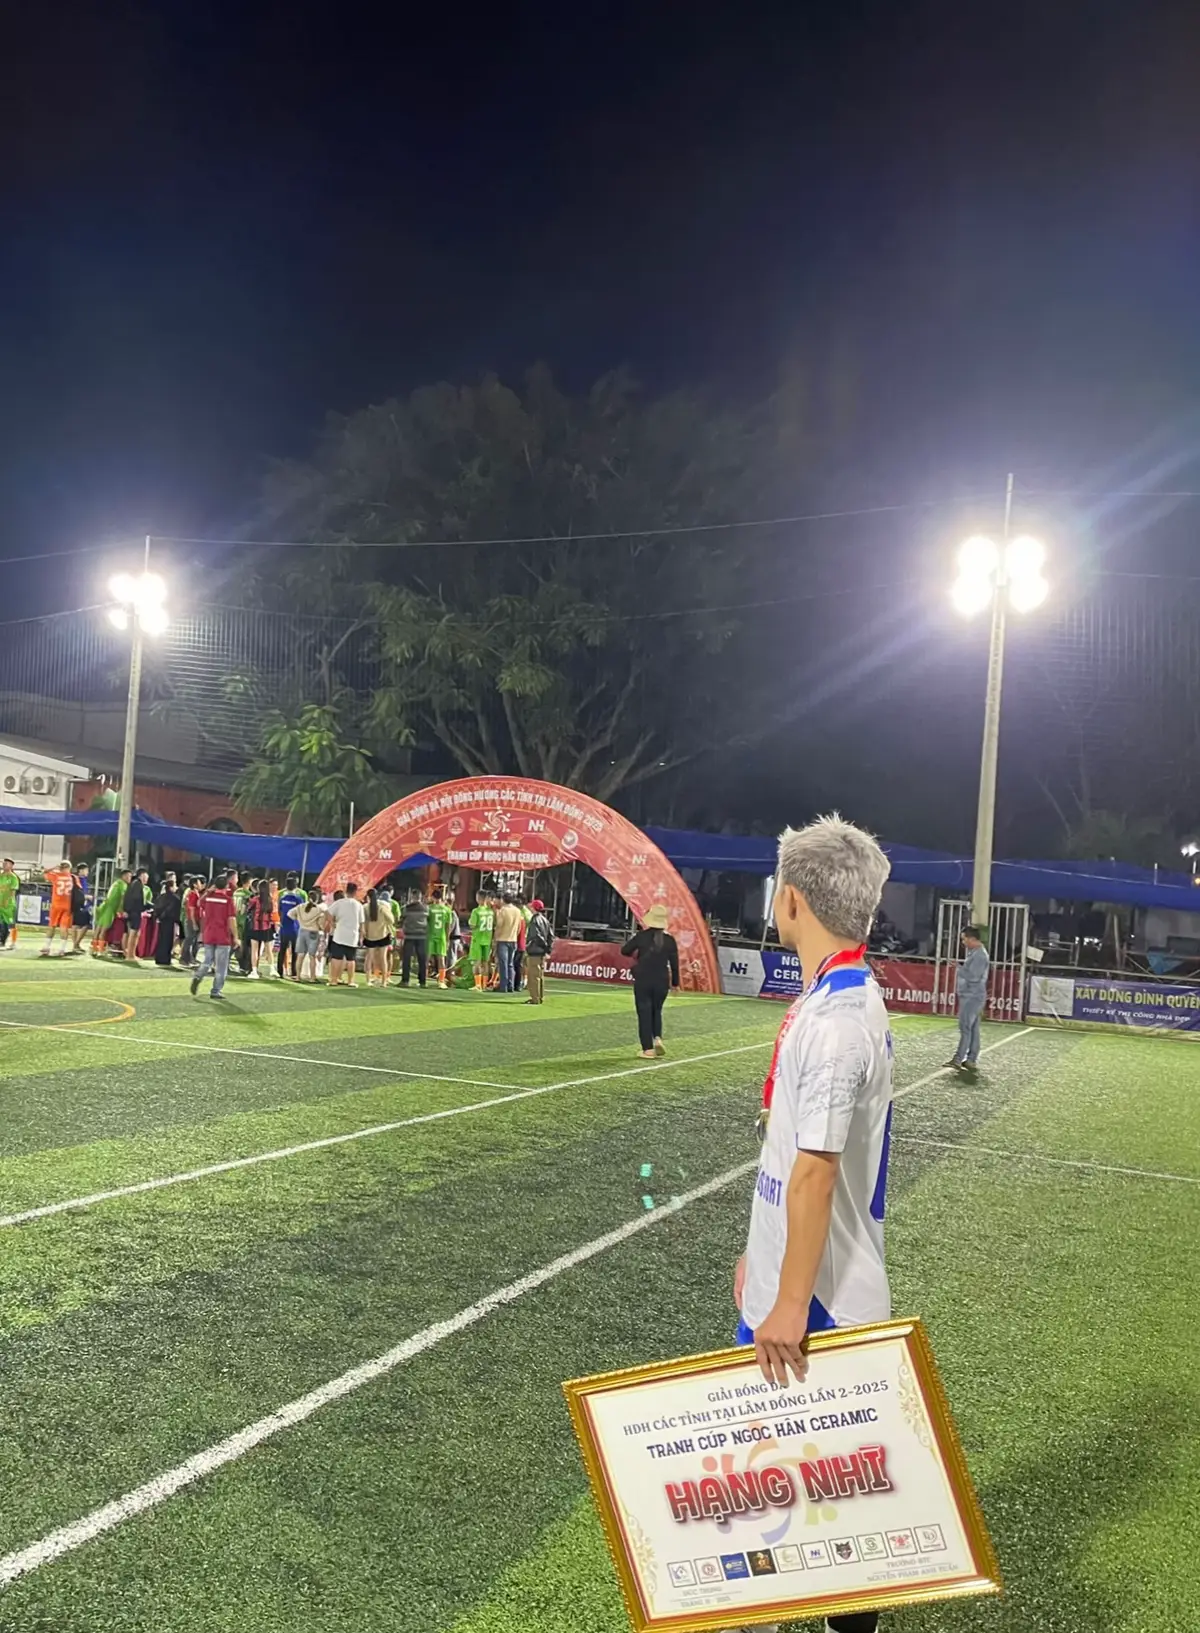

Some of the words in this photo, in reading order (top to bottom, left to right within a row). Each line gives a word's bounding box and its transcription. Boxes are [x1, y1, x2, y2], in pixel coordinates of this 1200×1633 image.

[56, 881, 73, 896] 22
[434, 913, 443, 929] 5
[543, 962, 593, 977] LAMDONG
[595, 966, 618, 979] CUP
[619, 969, 635, 981] 20
[773, 968, 803, 981] CER
[989, 997, 1020, 1011] 2025
[707, 1386, 733, 1403] GIẢI
[734, 1383, 768, 1400] BÓNG
[652, 1415, 678, 1431] CÁC
[677, 1410, 712, 1427] TỈNH
[712, 1405, 738, 1422] TẠI
[738, 1399, 767, 1417] LÂM
[838, 1379, 889, 1399] 2-2025
[646, 1438, 696, 1460] TRANH
[697, 1430, 728, 1451] CÚP
[731, 1425, 773, 1445] NGỌC
[774, 1417, 808, 1438] HÂN
[809, 1407, 879, 1432] CERAMIC
[664, 1465, 796, 1524] HẠNG
